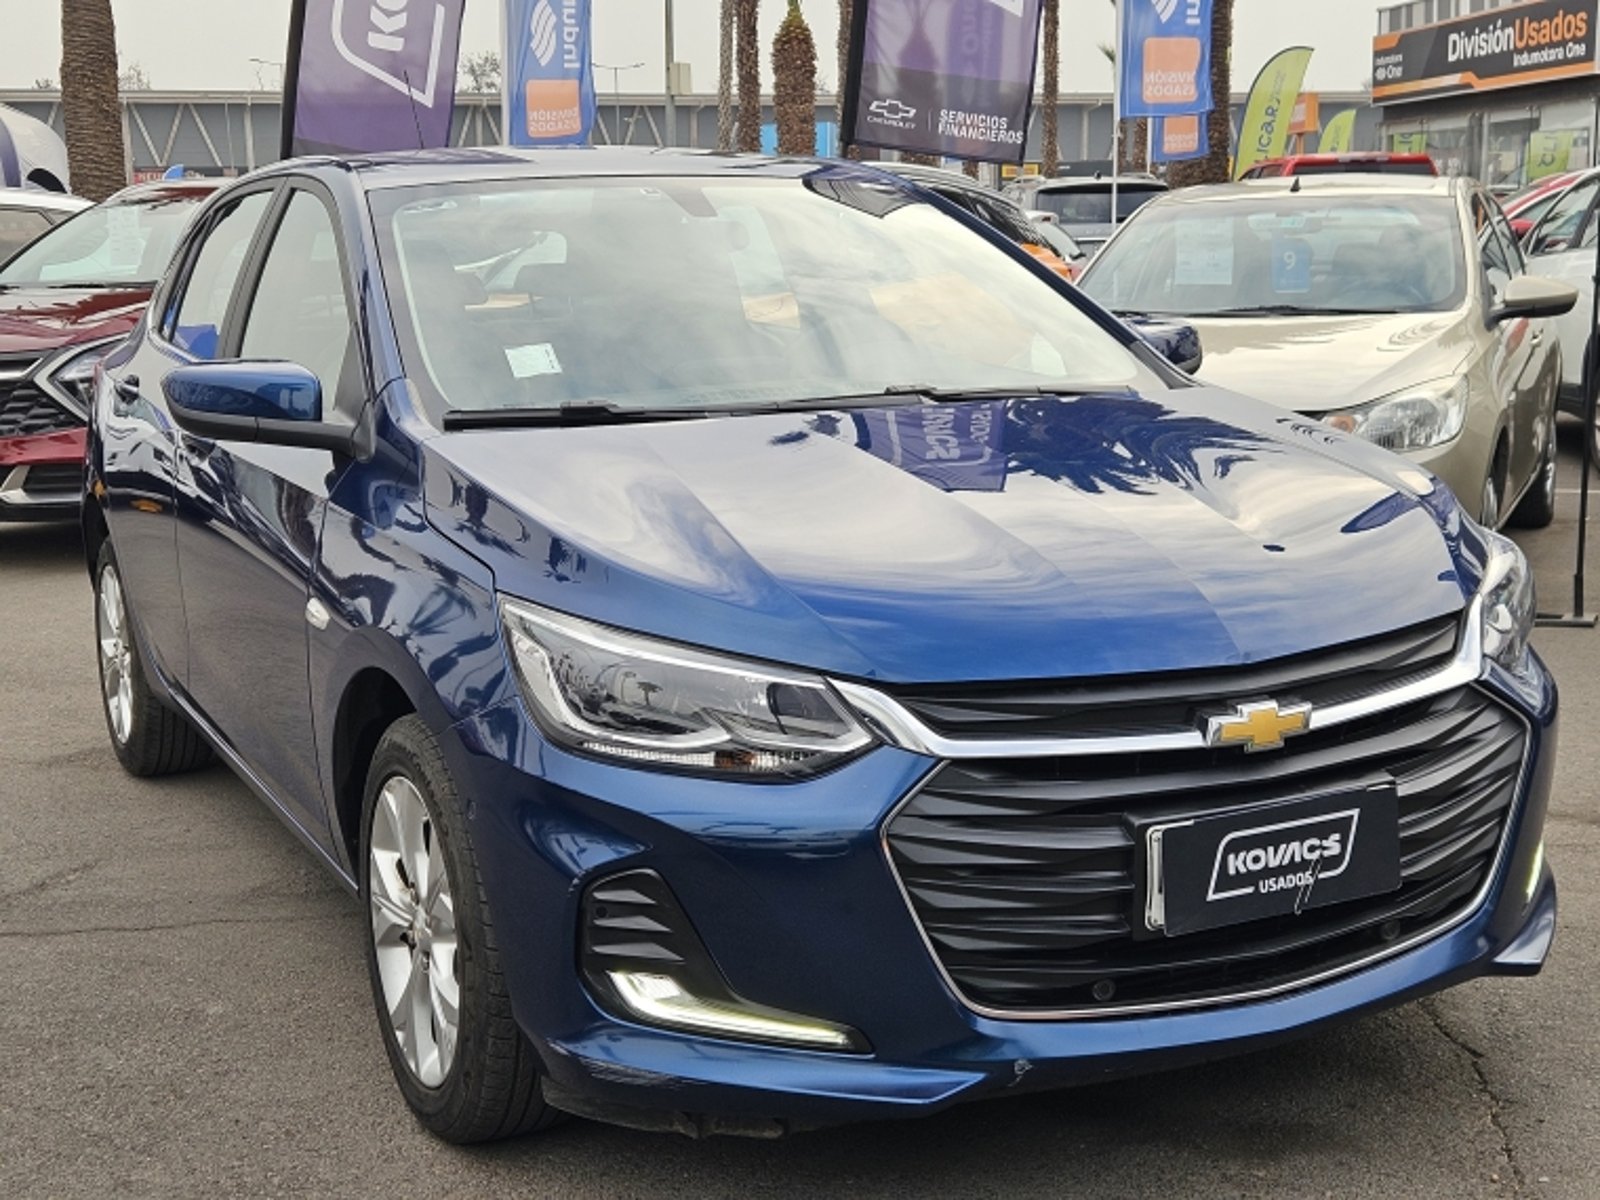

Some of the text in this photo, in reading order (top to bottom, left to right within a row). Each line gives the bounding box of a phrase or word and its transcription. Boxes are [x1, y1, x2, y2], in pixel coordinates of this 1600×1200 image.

[1566, 41, 1587, 59] One
[938, 108, 1009, 130] SERVICIOS
[938, 122, 1024, 145] FINANCIEROS
[1283, 250, 1297, 271] 9
[1226, 832, 1342, 876] KOVACS
[1258, 870, 1315, 894] USADOS
